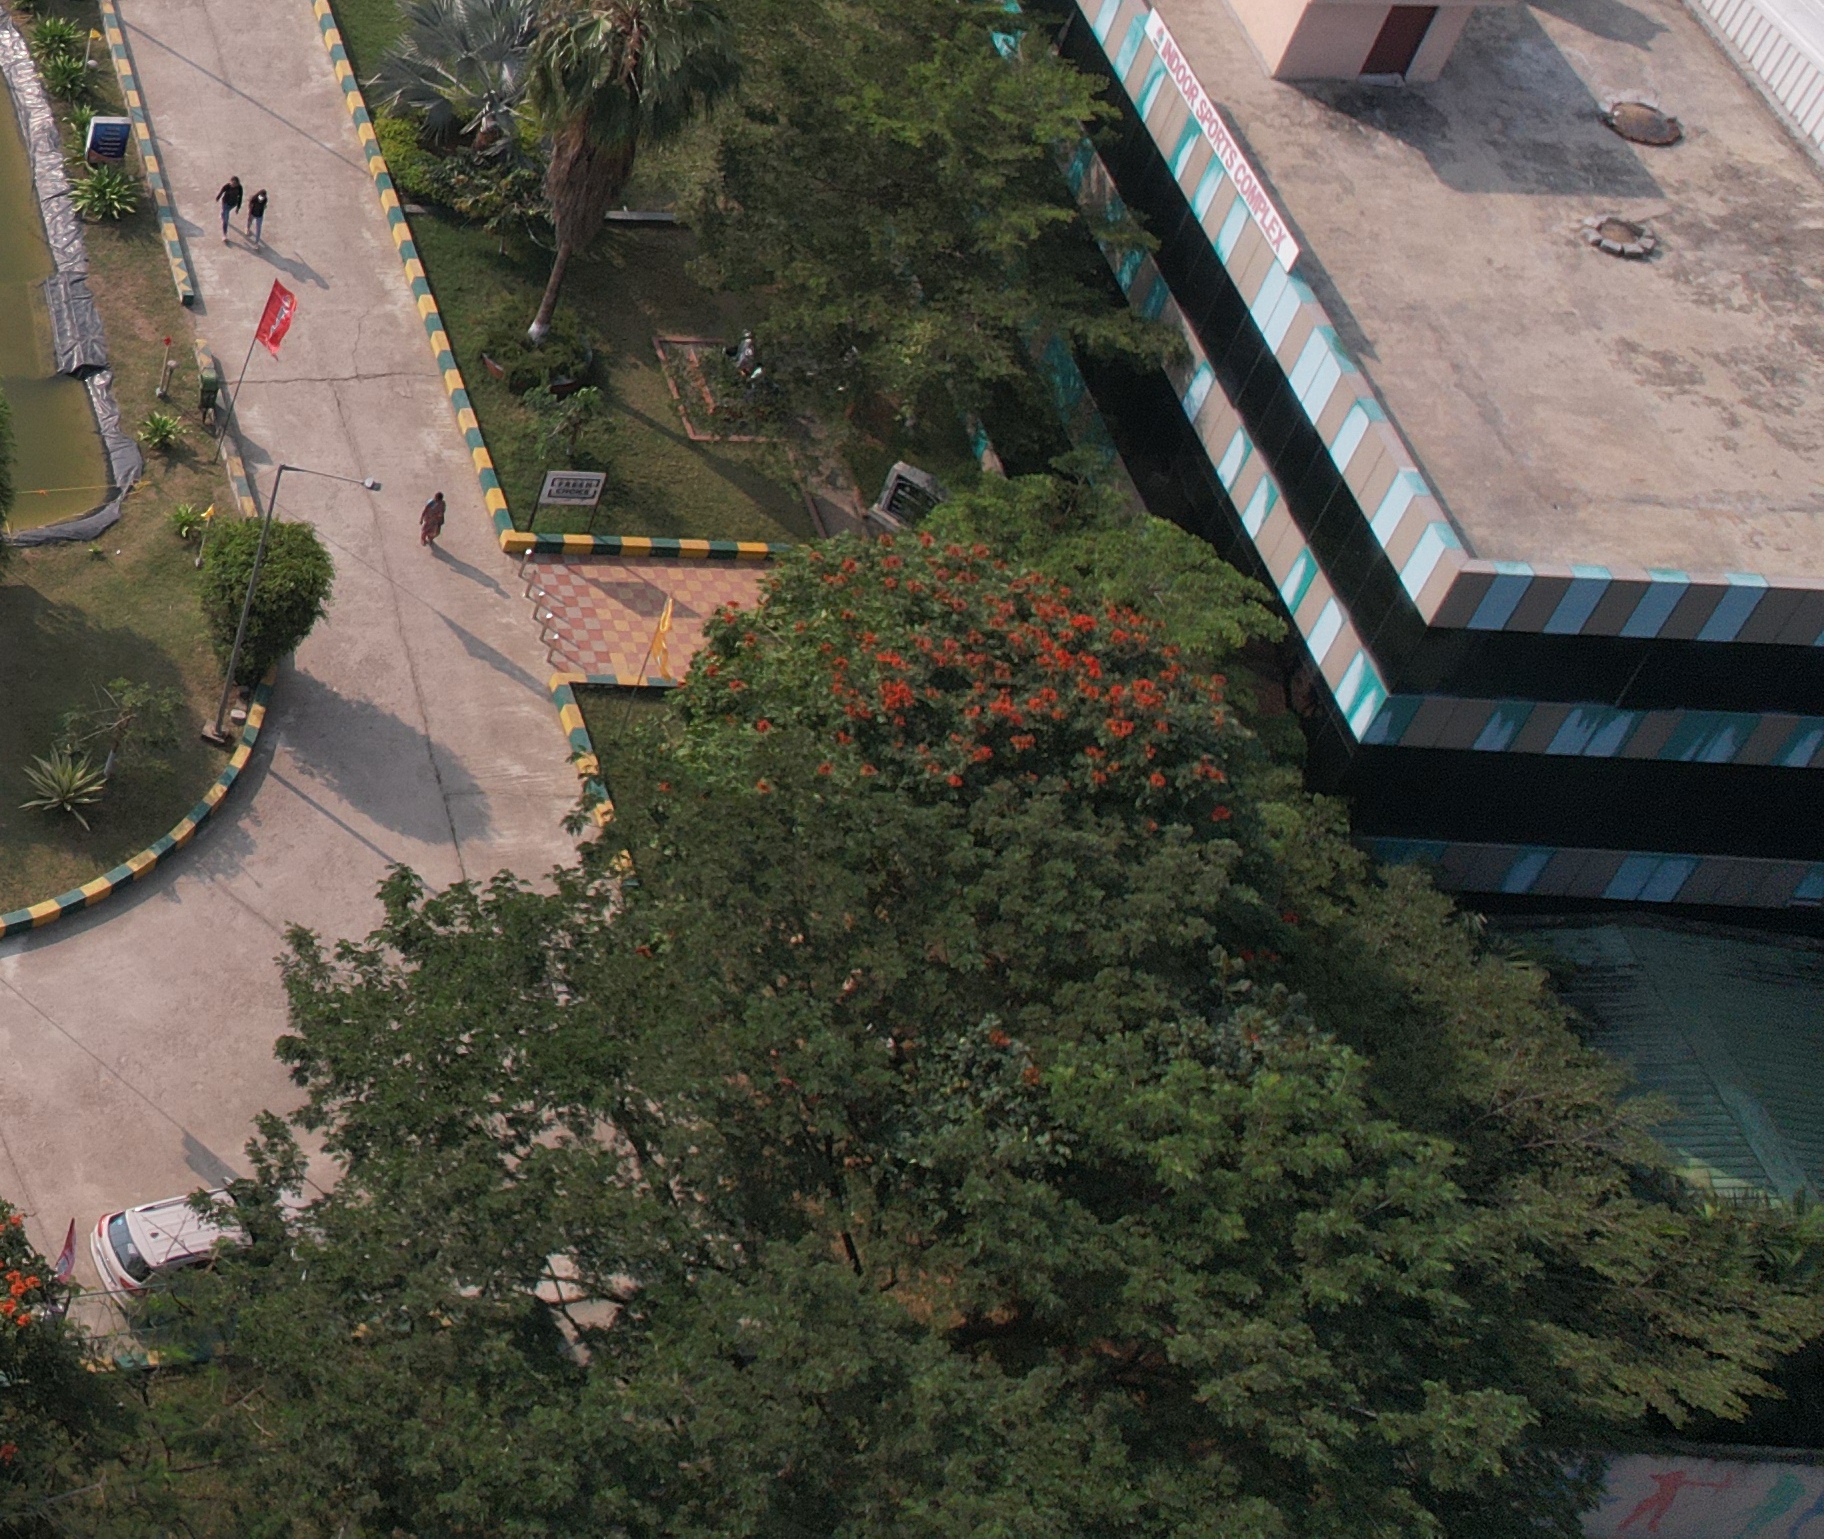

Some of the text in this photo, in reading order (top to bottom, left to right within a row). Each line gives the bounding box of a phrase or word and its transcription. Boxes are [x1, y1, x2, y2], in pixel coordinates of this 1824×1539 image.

[1161, 37, 1287, 253] INDOOR SPORTS COMPLEX
